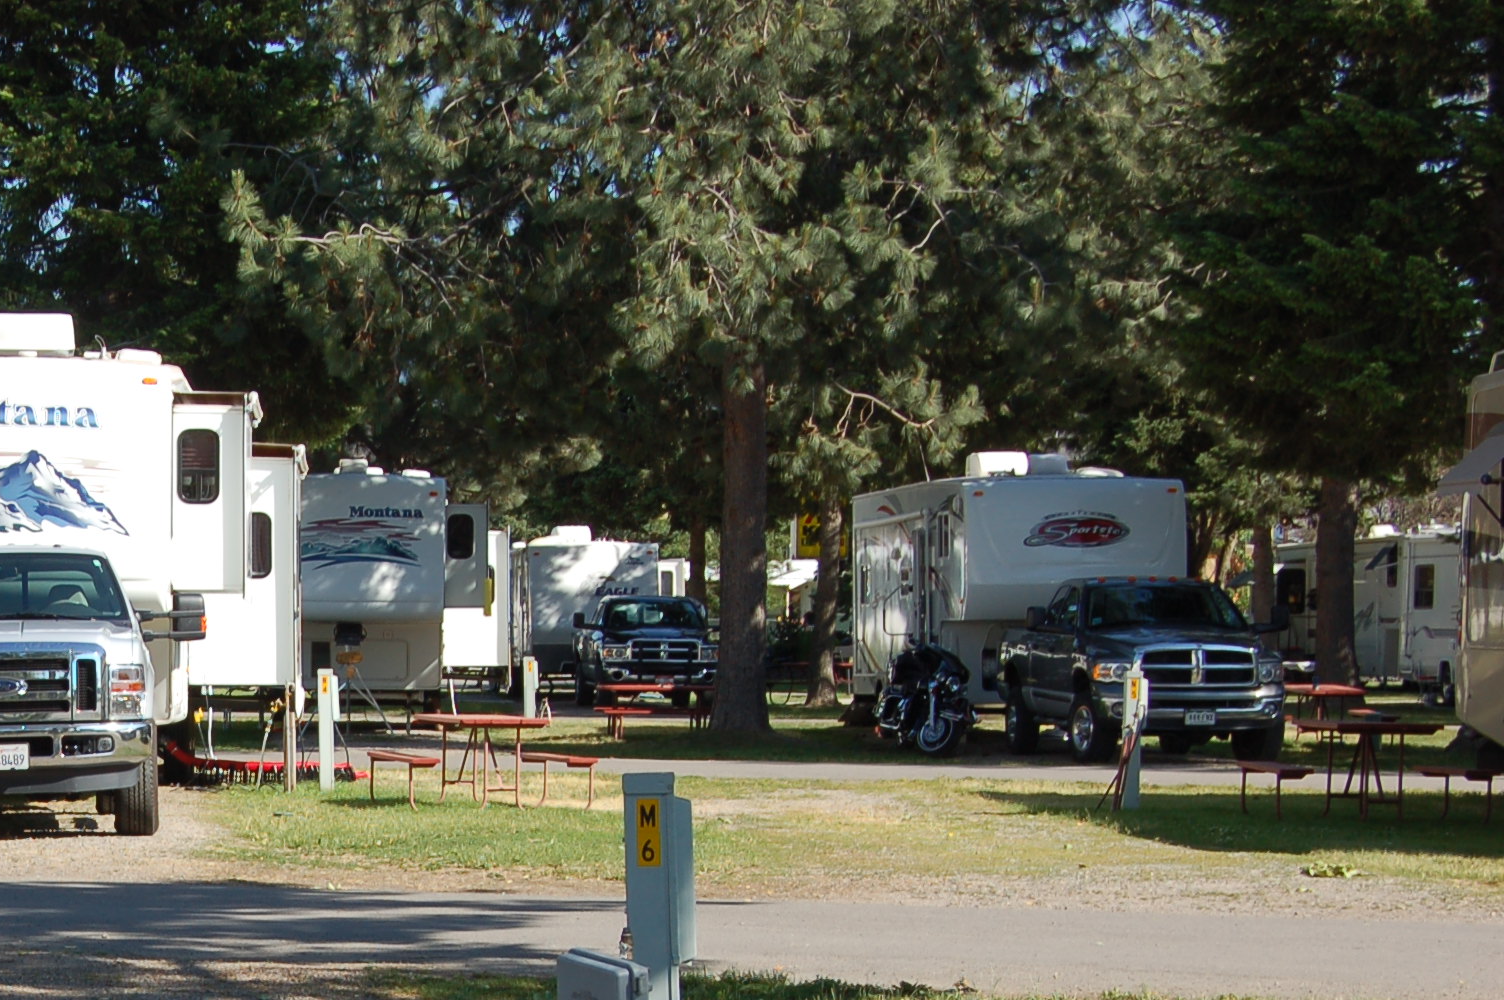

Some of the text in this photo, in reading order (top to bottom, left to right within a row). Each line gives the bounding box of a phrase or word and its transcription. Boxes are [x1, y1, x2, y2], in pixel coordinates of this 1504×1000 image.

[349, 506, 424, 519] Montana
[595, 586, 639, 596] EAGLE
[640, 804, 656, 828] M
[642, 839, 655, 862] 6
